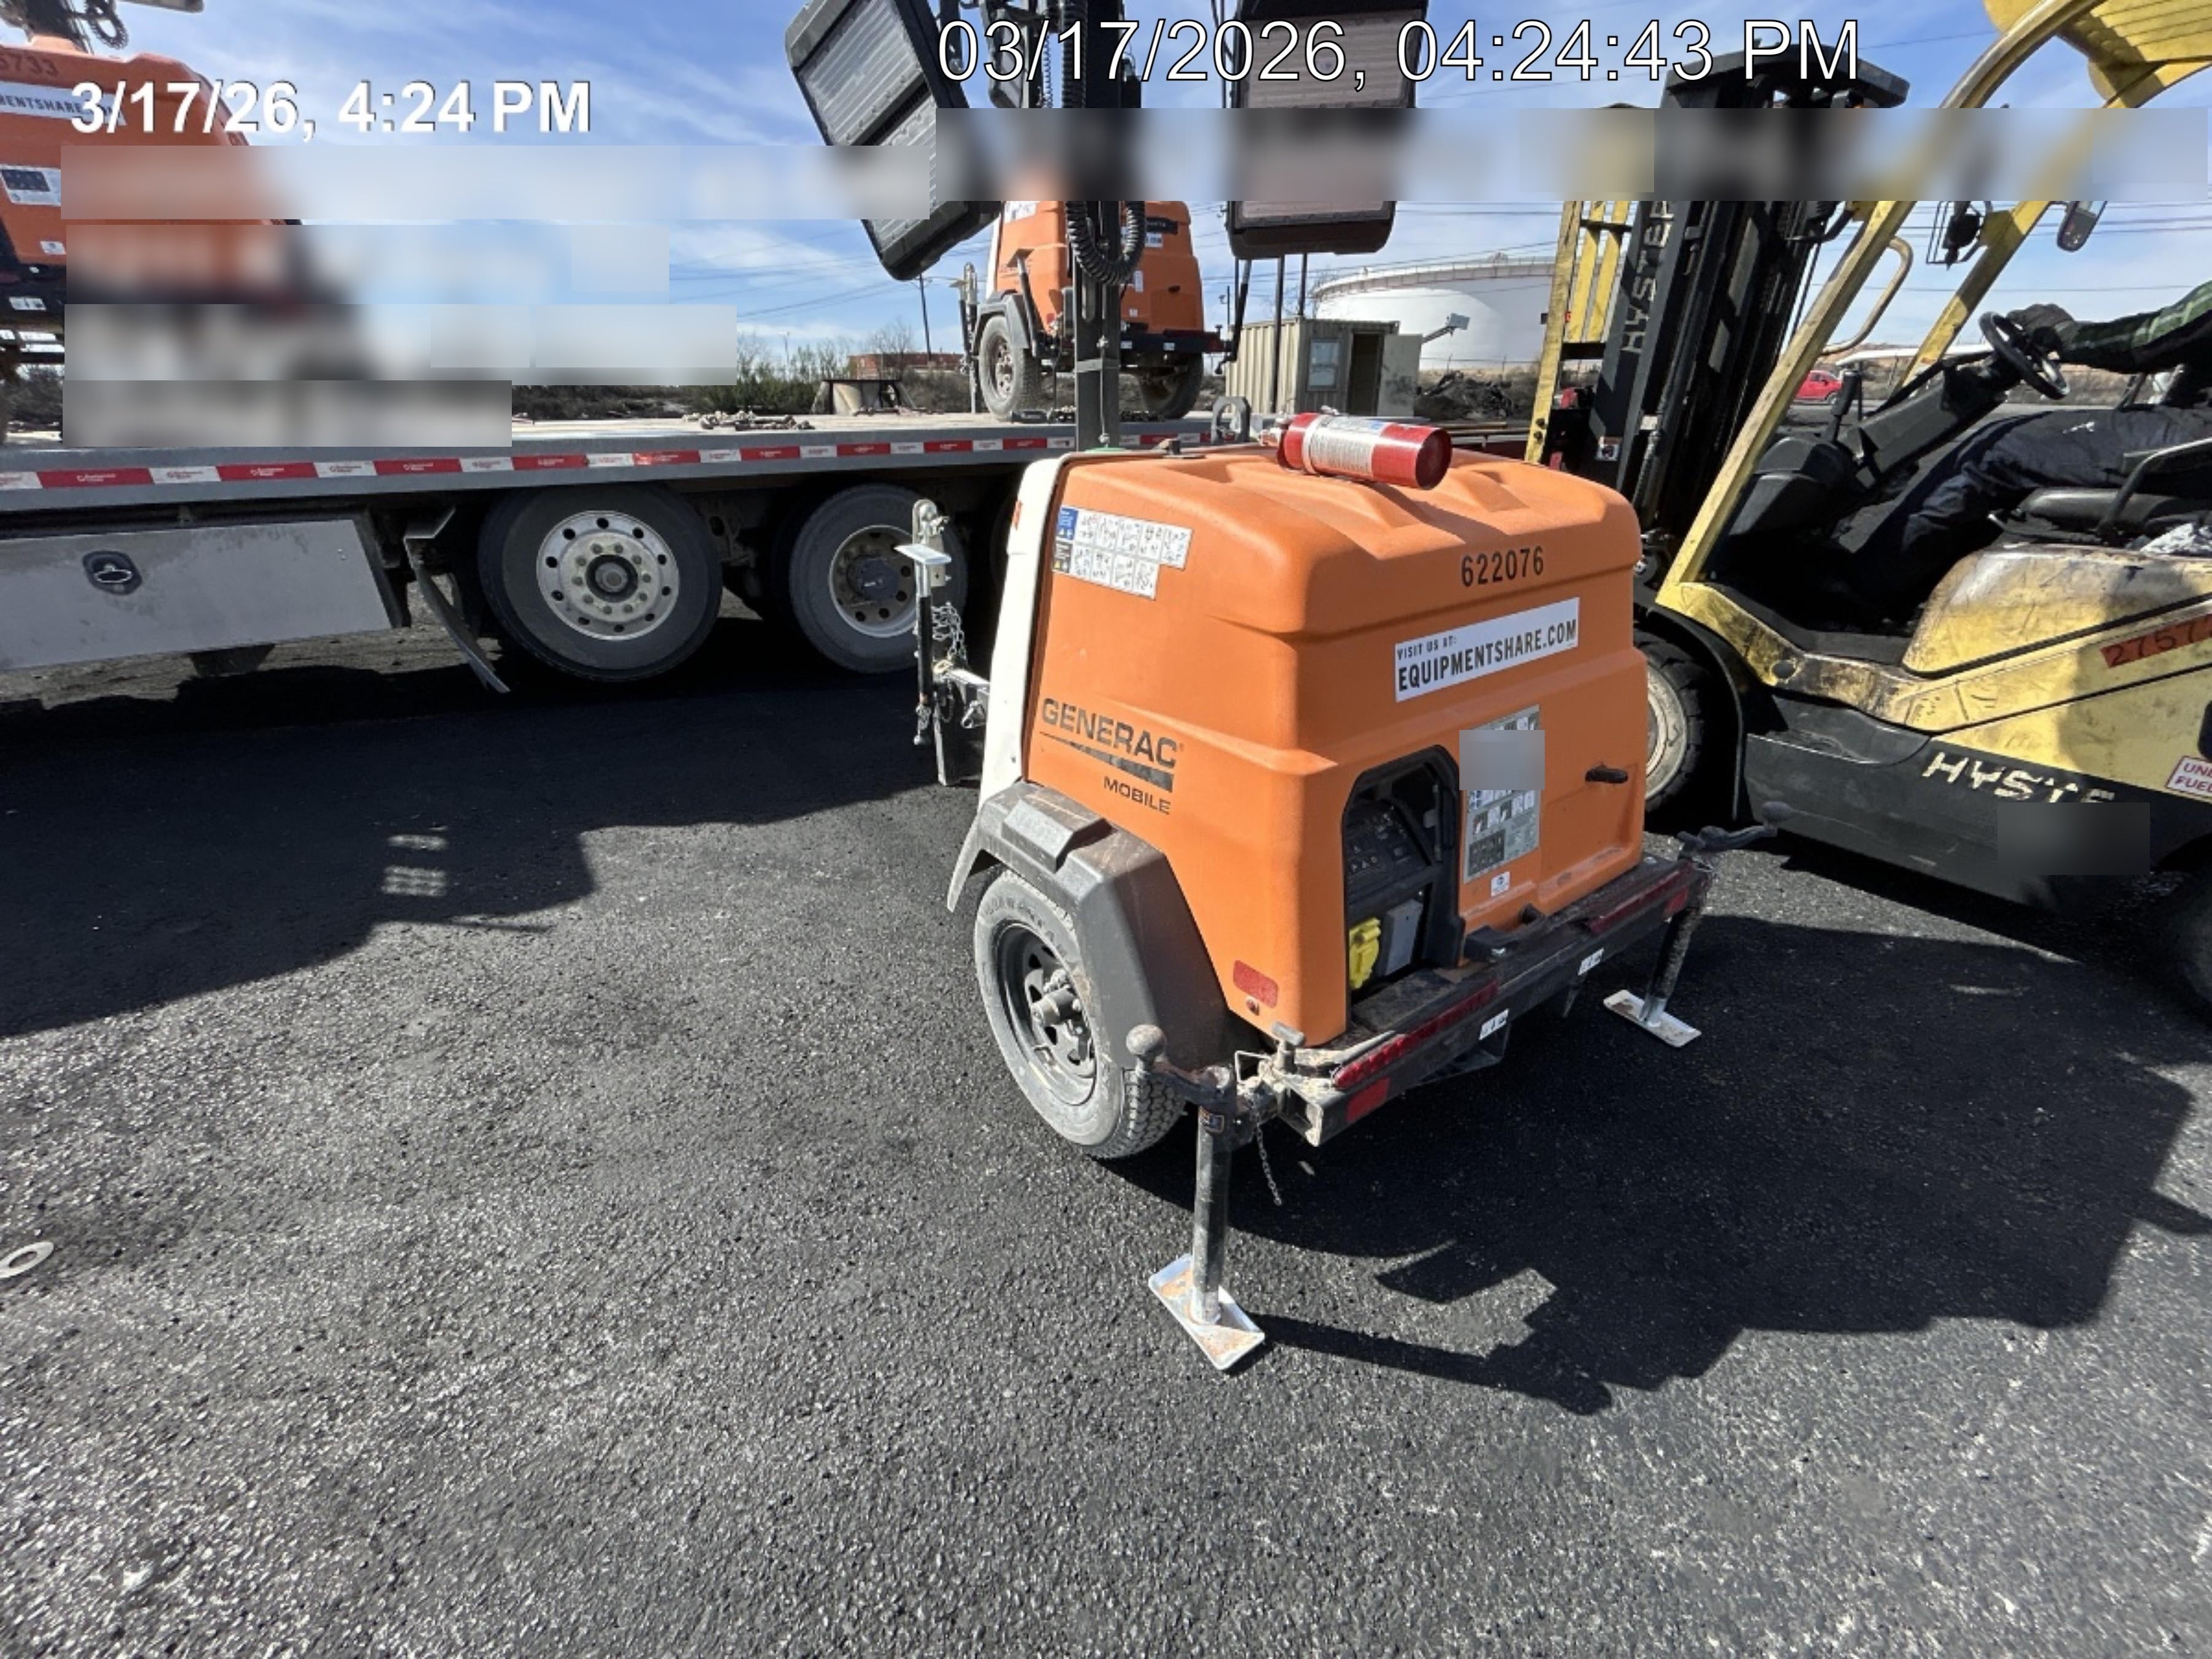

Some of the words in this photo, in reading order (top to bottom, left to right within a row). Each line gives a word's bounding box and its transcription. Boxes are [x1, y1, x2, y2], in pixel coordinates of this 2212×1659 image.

[1461, 546, 1544, 587] 622076
[1397, 643, 1422, 661] VISIT
[1426, 639, 1439, 653] US
[1398, 618, 1578, 692] EQUIPMENTSHARE.COM
[1041, 698, 1177, 769] GENERAC
[1104, 775, 1172, 816] MOBILE
